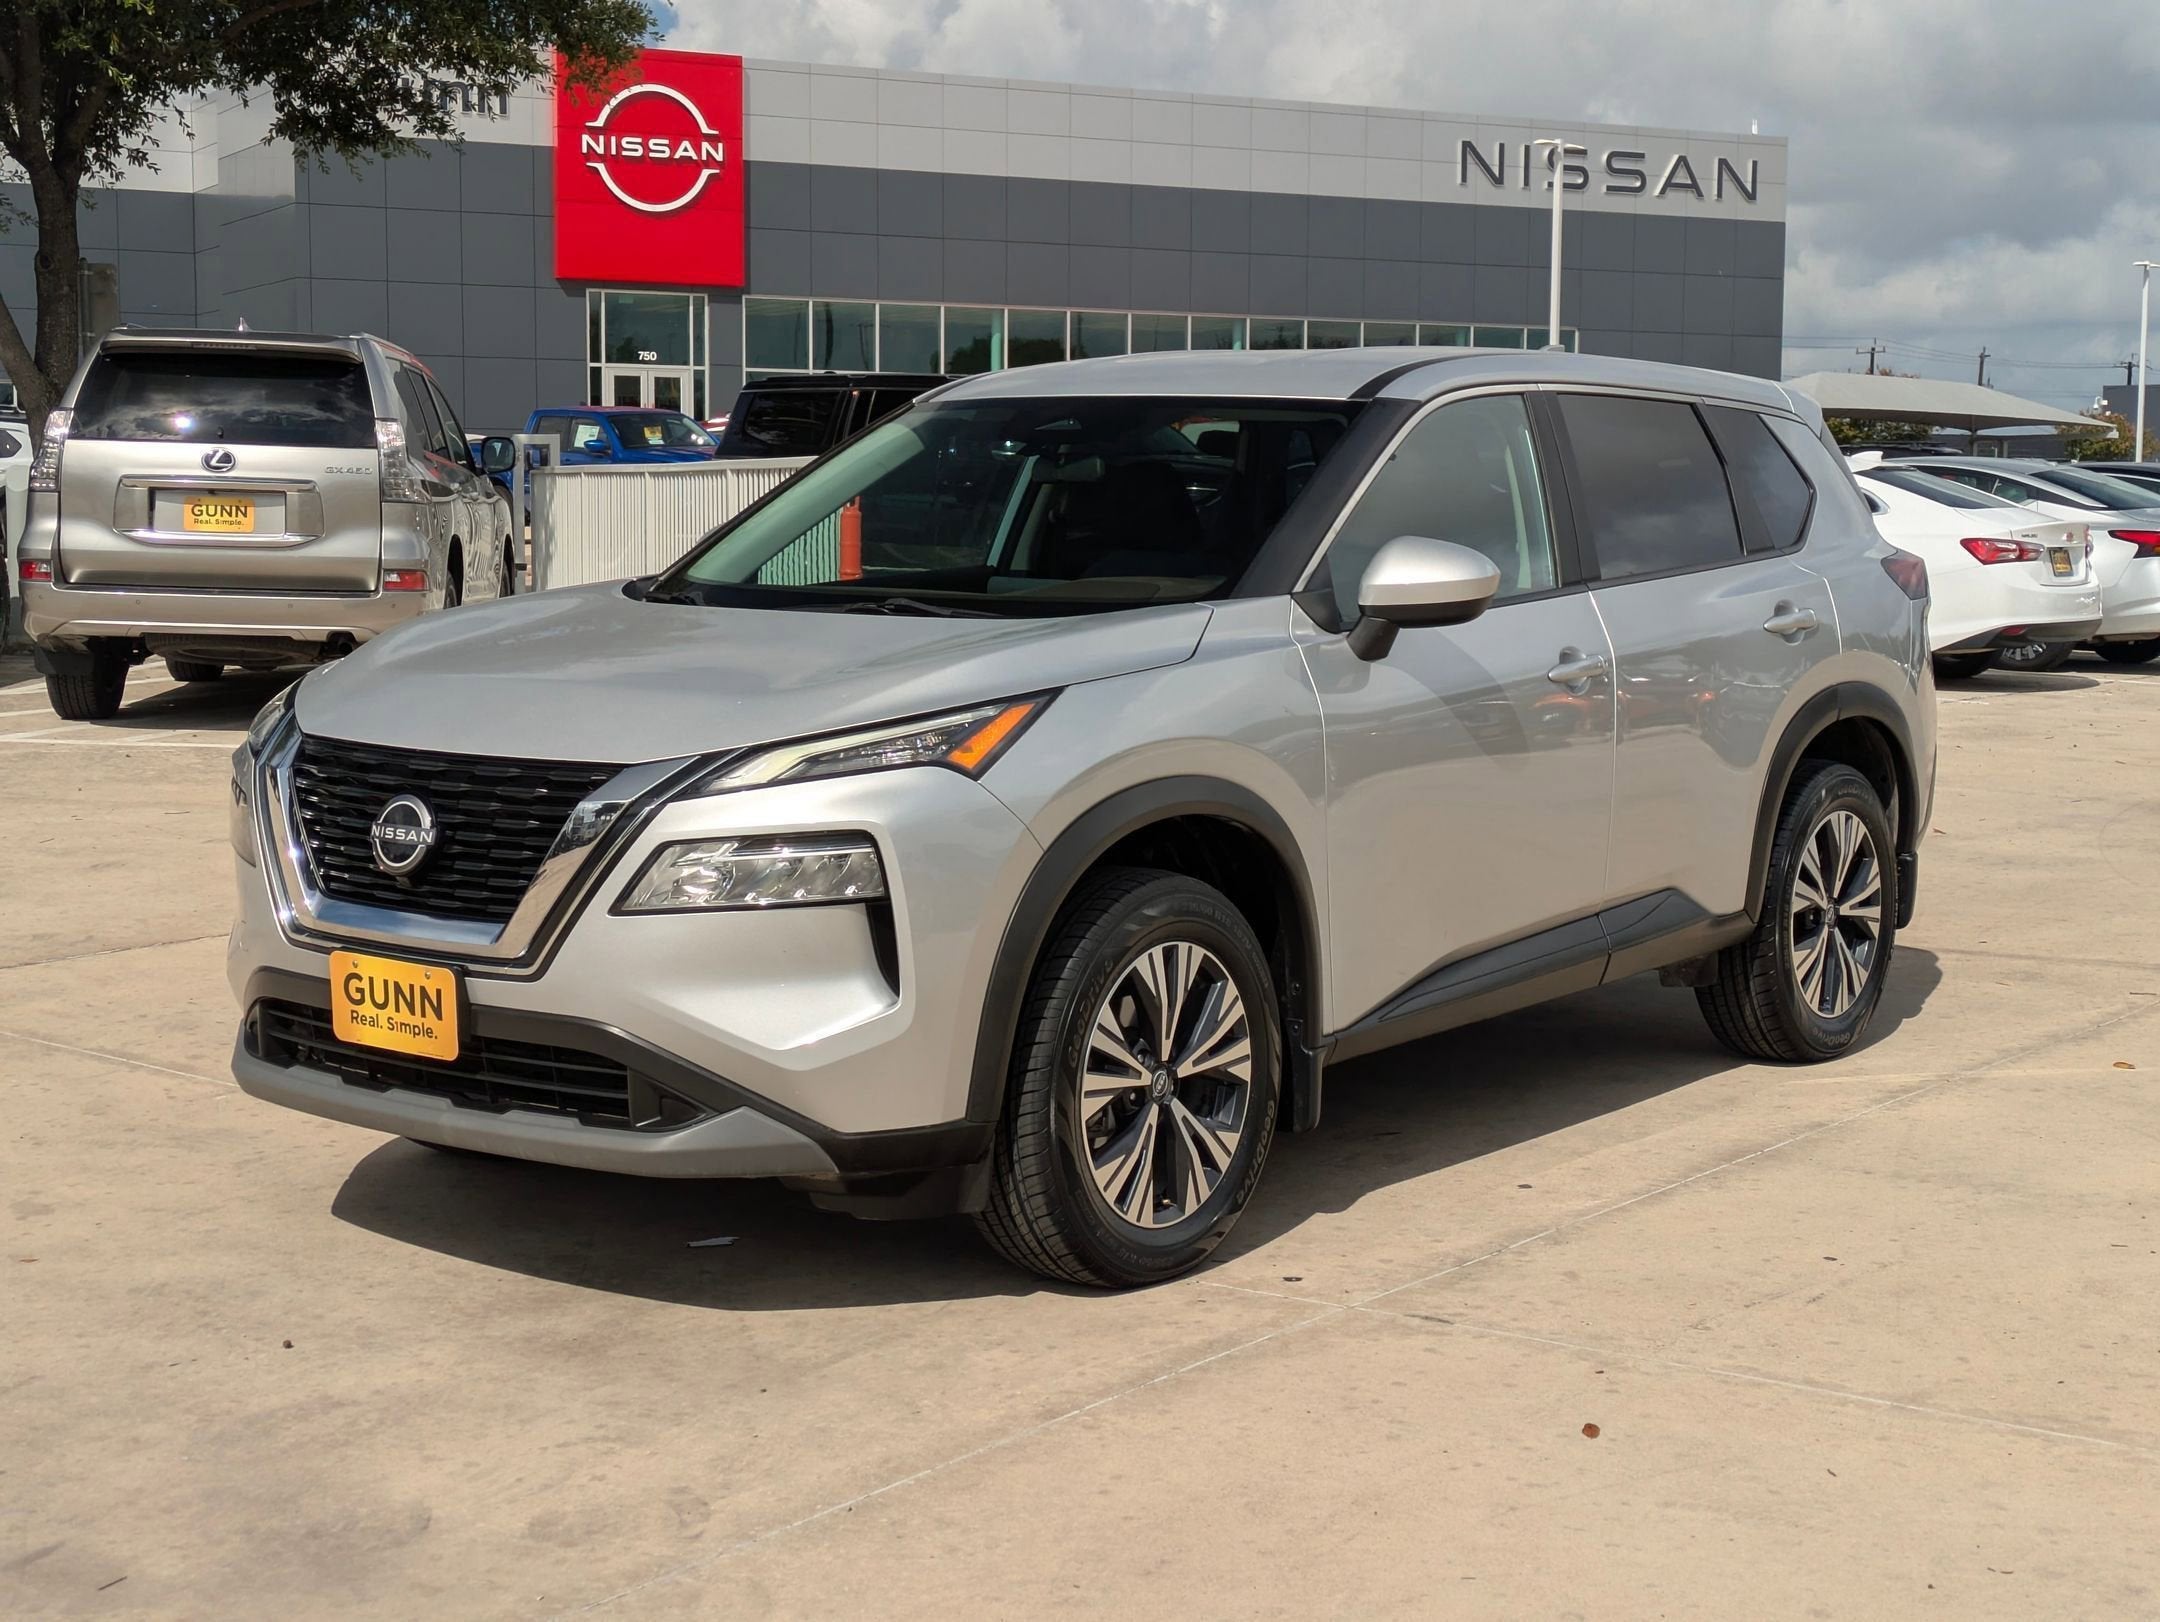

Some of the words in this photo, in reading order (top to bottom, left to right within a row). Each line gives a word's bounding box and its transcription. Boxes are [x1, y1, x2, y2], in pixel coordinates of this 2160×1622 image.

[581, 134, 724, 162] NISSAN
[1458, 139, 1759, 203] NISSAN
[637, 351, 658, 361] 750
[191, 503, 249, 518] GUNN
[371, 824, 433, 843] NISSAN
[343, 972, 443, 1022] GUNN
[350, 1009, 384, 1030] Real.
